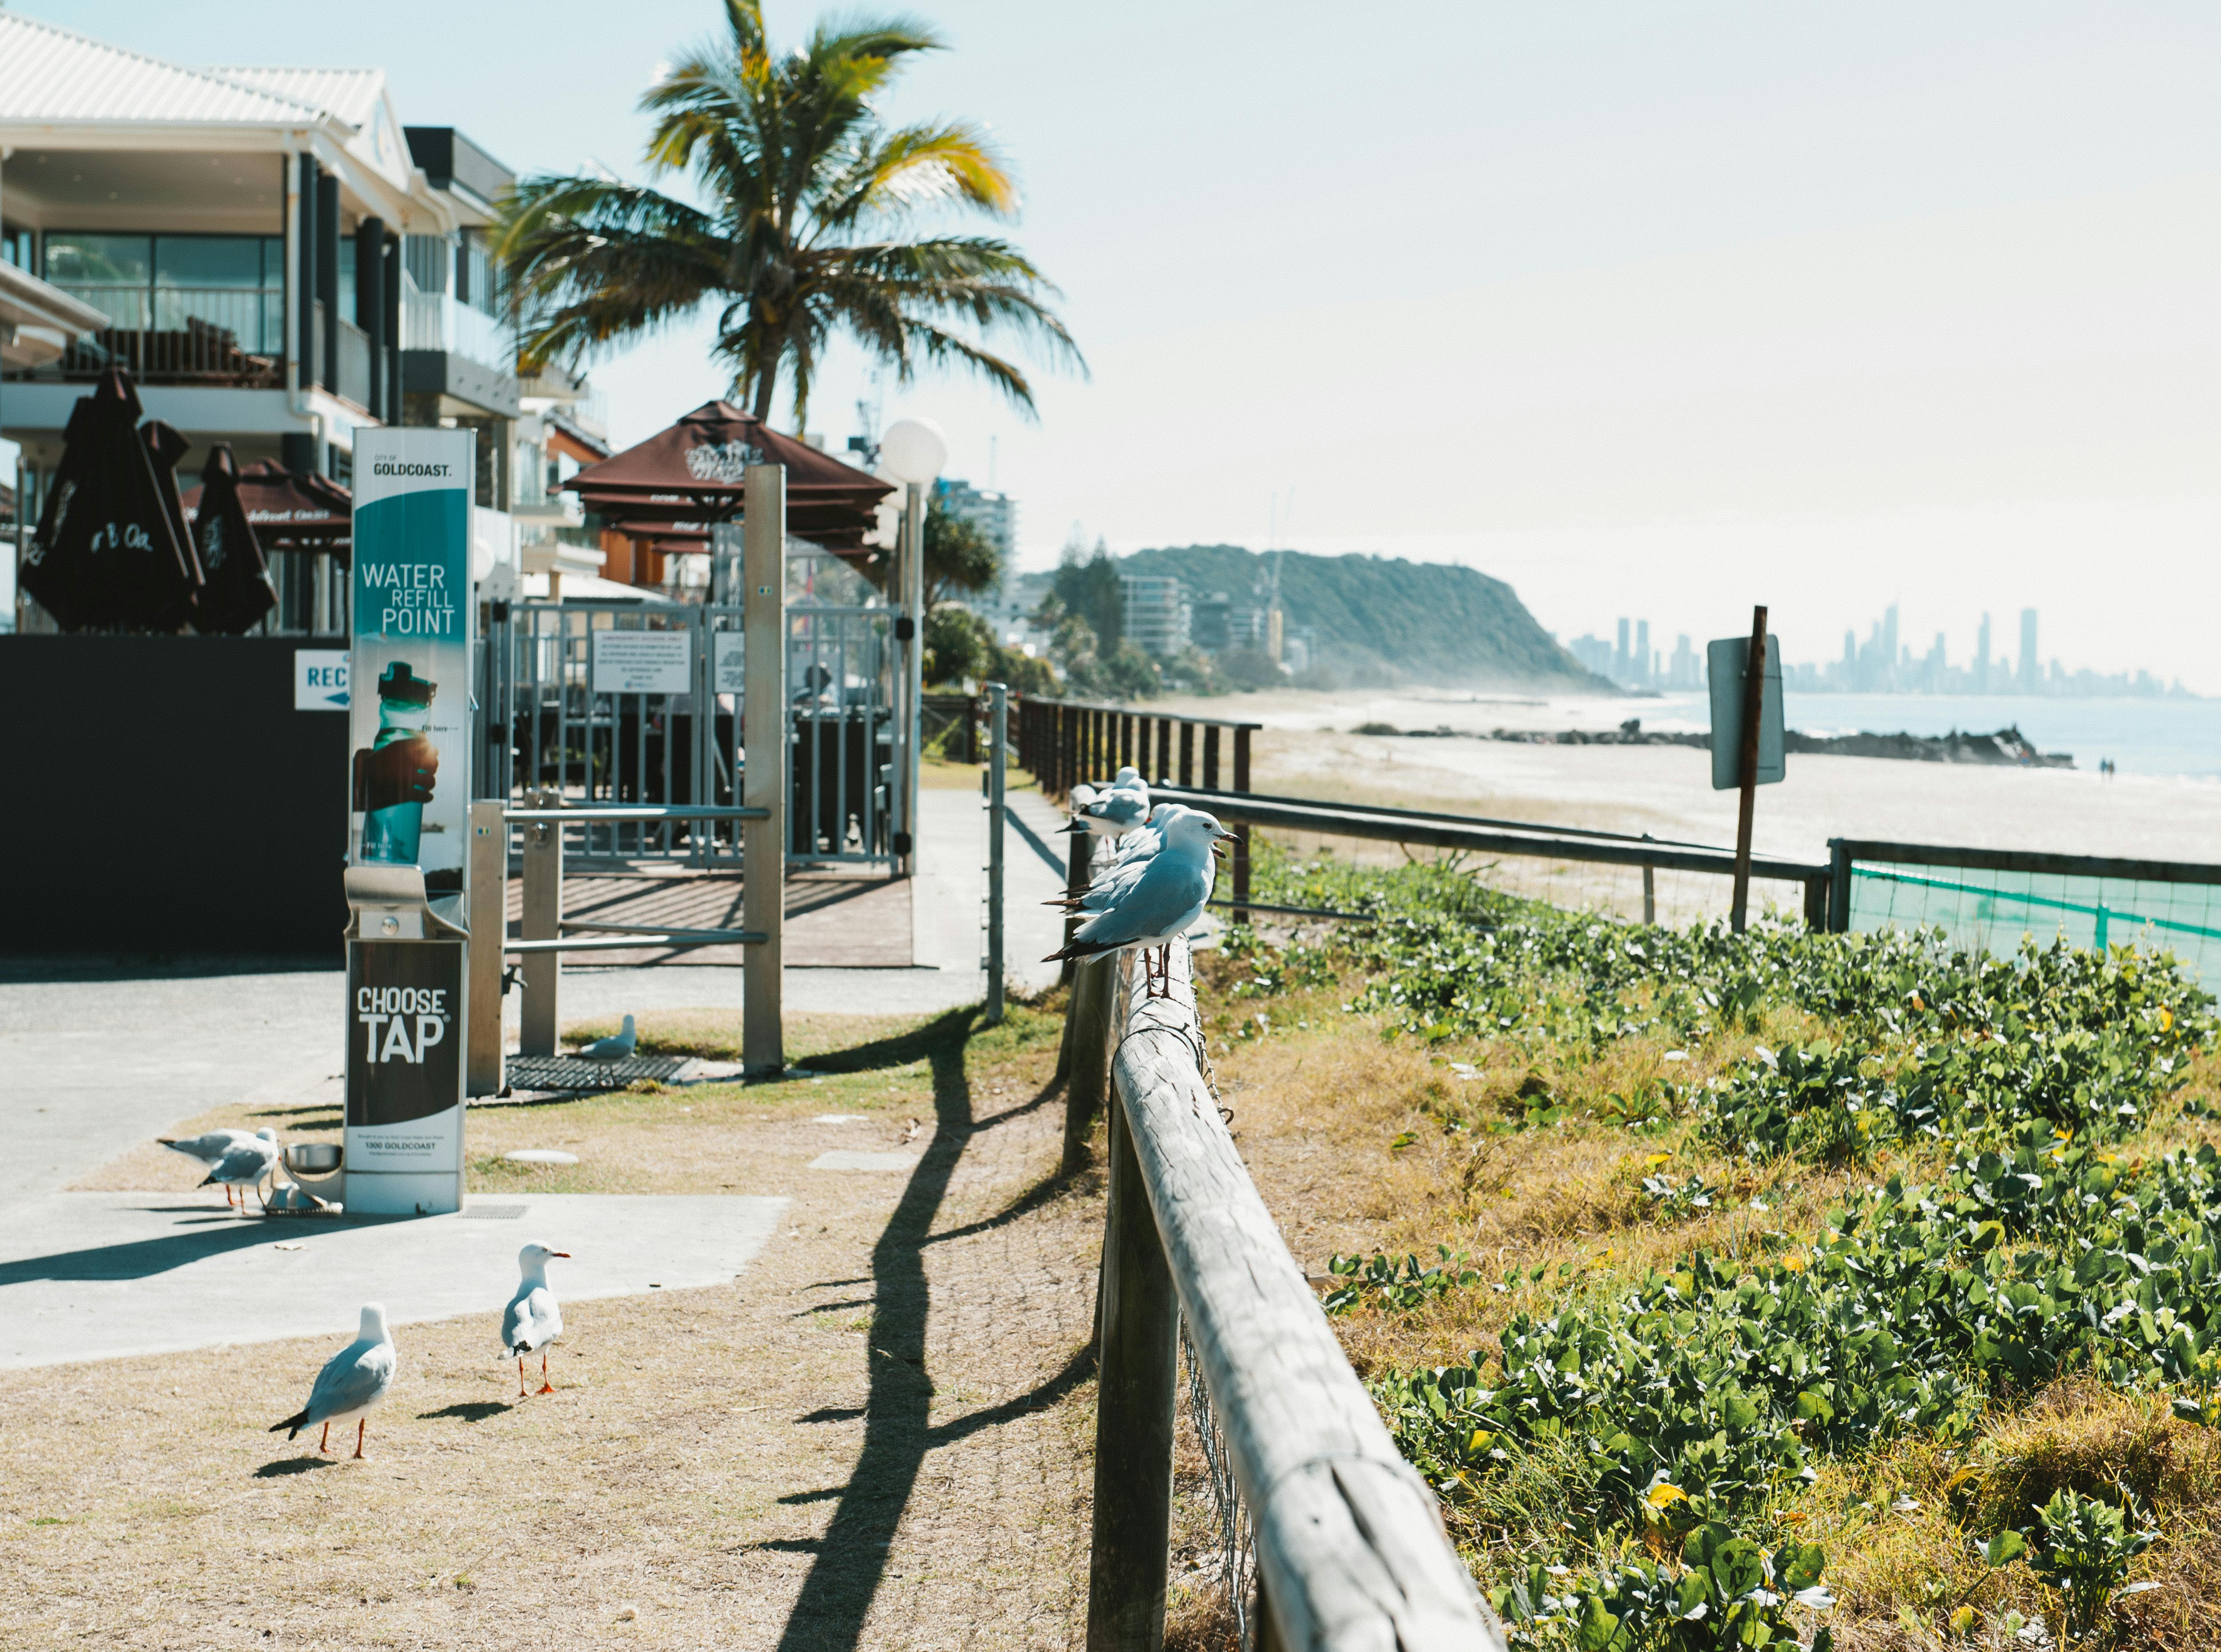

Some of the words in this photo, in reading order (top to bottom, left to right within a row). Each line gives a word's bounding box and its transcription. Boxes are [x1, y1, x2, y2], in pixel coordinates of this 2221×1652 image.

[362, 563, 445, 589] WATER
[391, 589, 454, 608] REFILL
[382, 608, 455, 634] POINT
[357, 987, 446, 1014] CHOOSE
